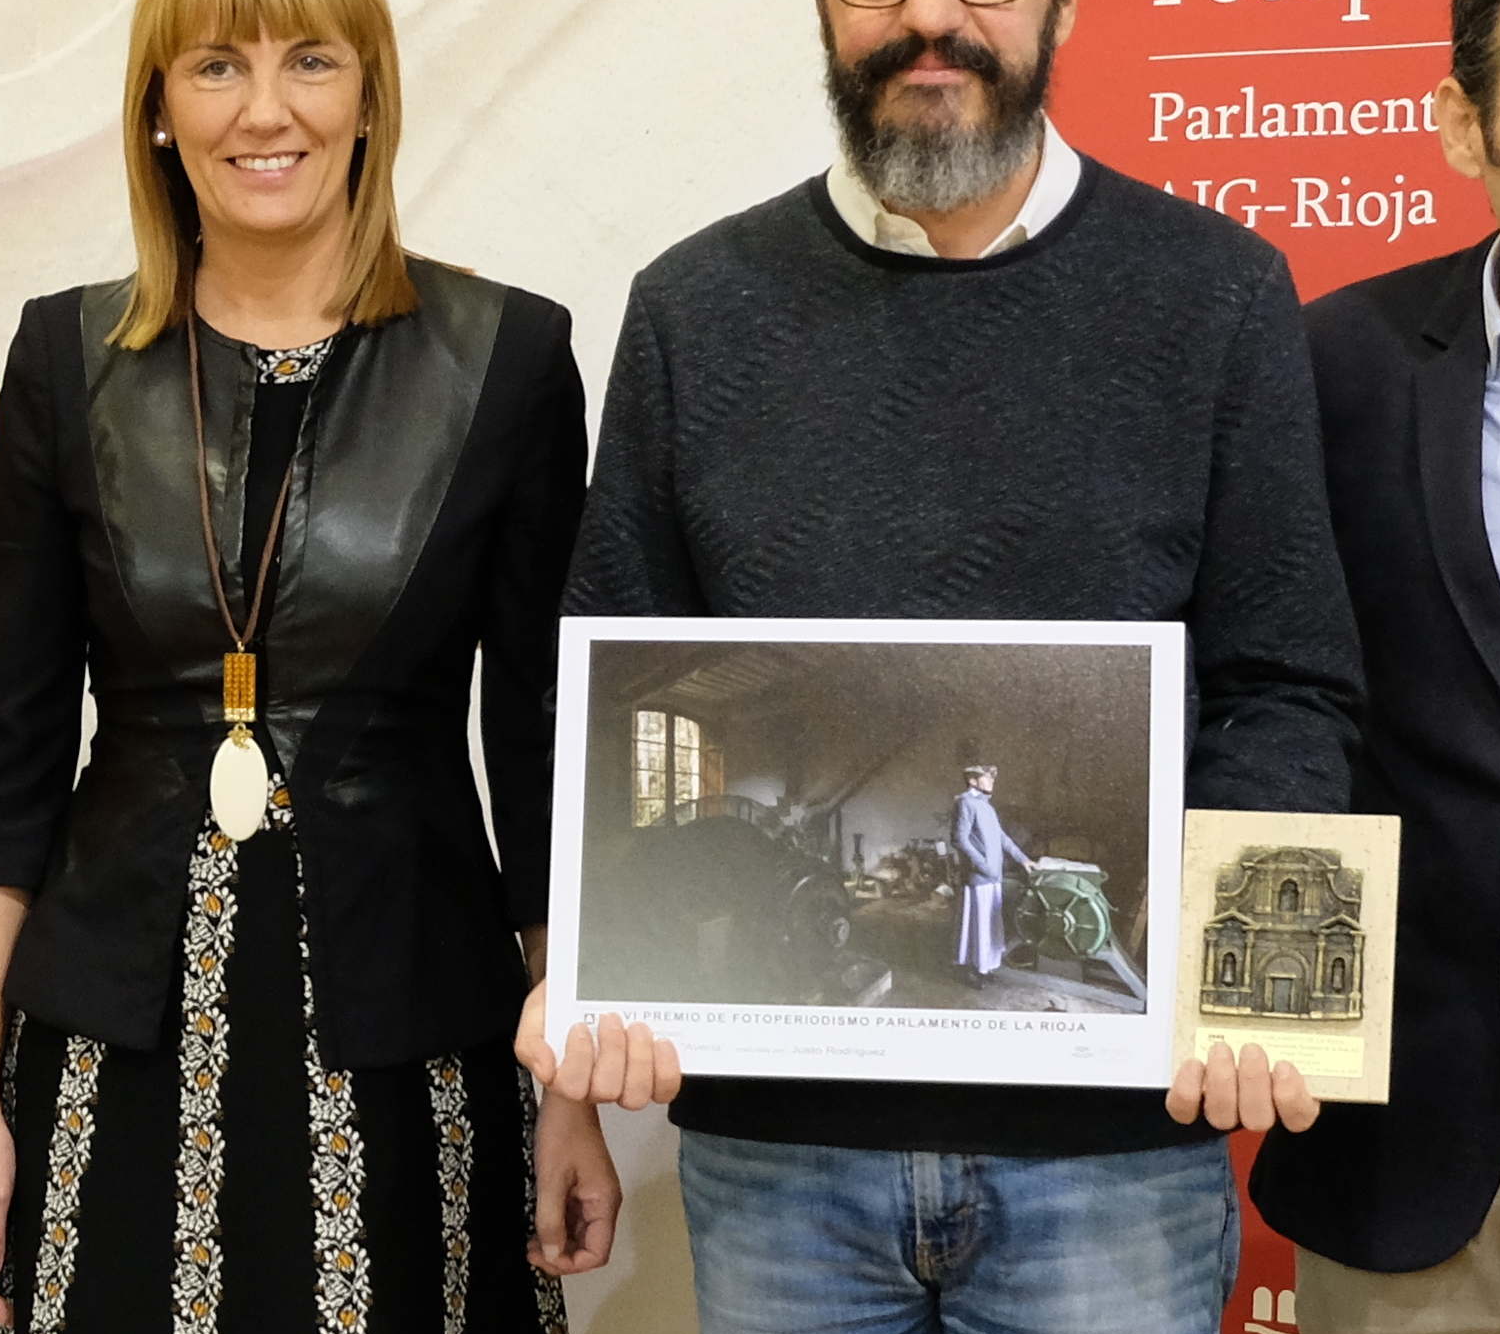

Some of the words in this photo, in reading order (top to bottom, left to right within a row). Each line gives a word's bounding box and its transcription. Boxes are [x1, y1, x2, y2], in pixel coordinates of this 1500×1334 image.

[1148, 86, 1440, 142] Parlament
[622, 1011, 637, 1021] VI
[643, 1012, 700, 1023] PREMIO
[706, 1012, 726, 1024] DE
[732, 1013, 870, 1027] FOTOPERIODISMO
[876, 1016, 982, 1030] PARLAMENTO
[988, 1019, 1008, 1031] DE
[1014, 1020, 1033, 1032] LA
[1039, 1020, 1088, 1033] RIOJA
